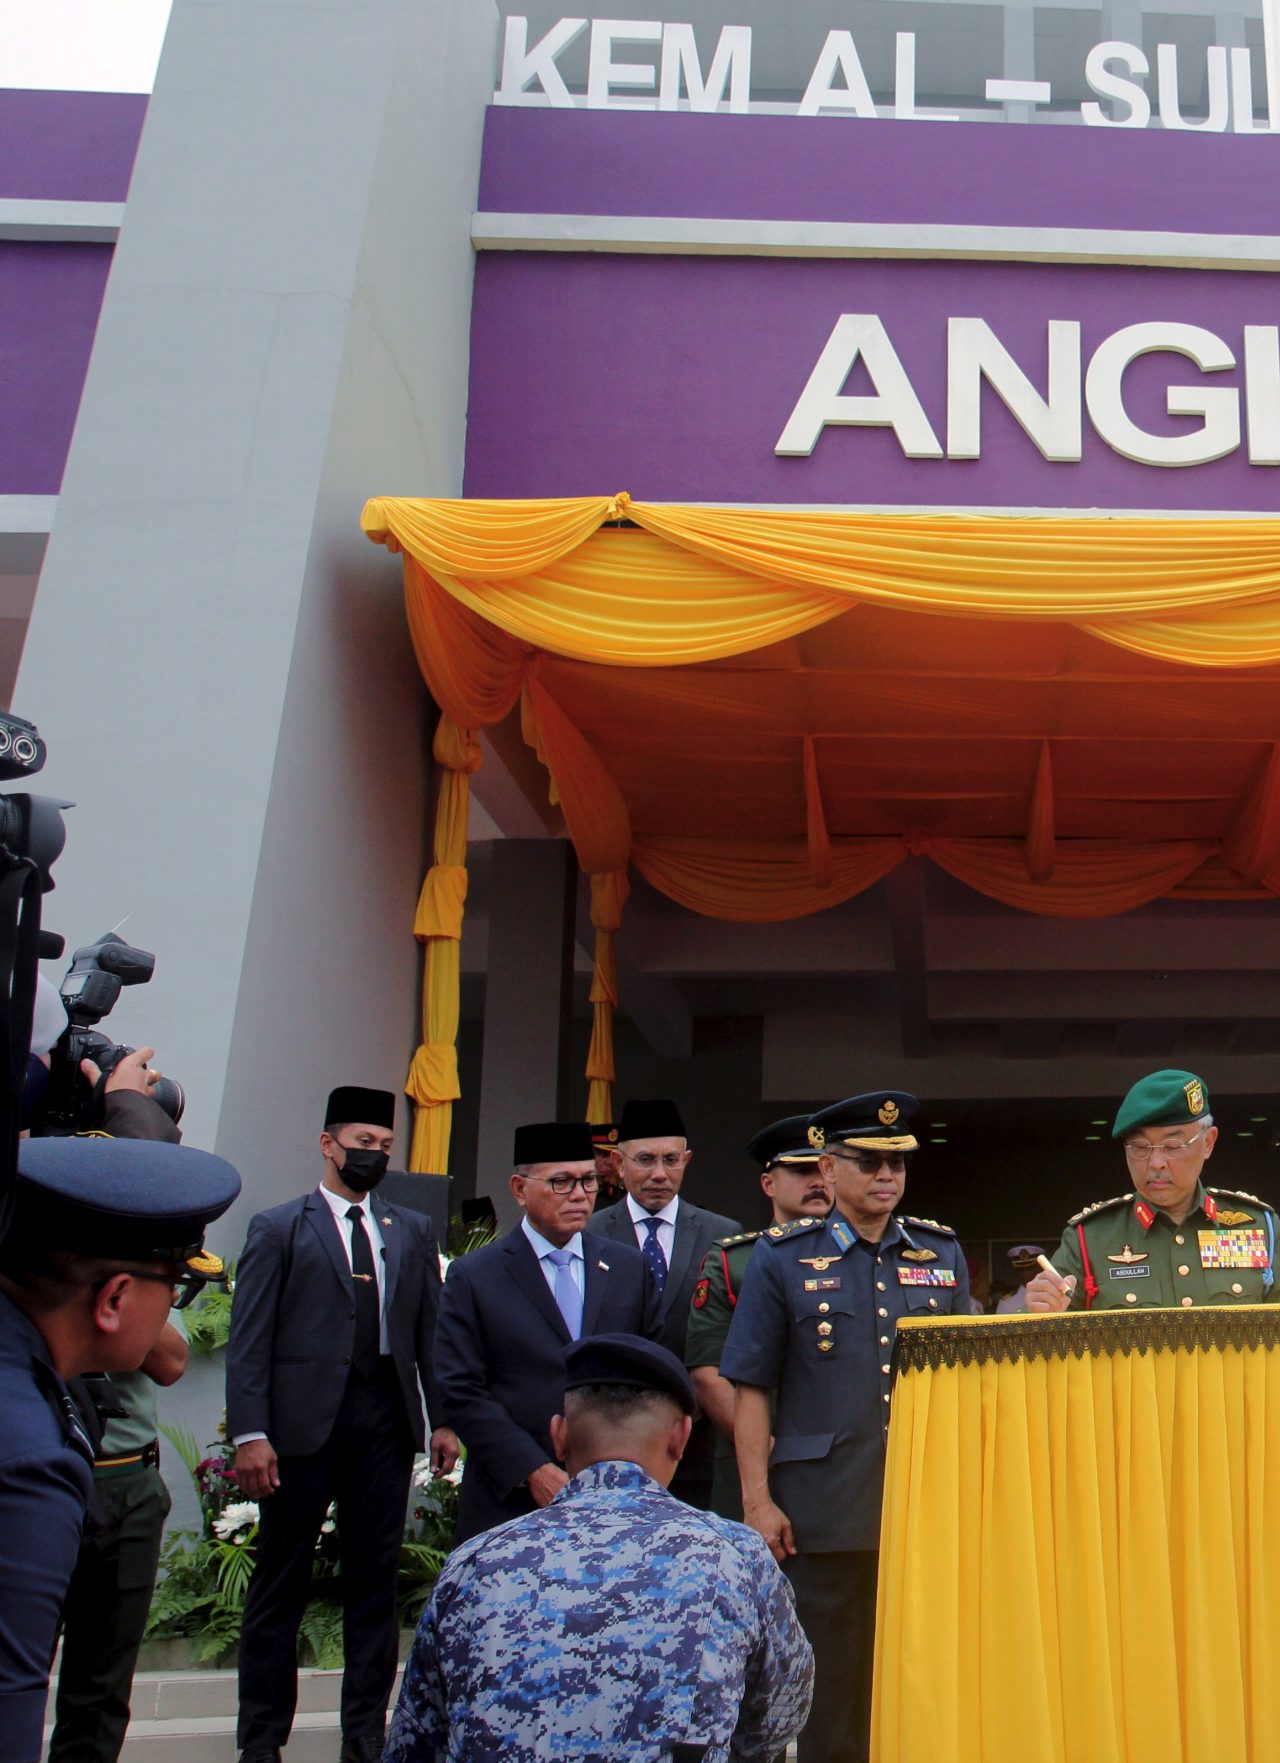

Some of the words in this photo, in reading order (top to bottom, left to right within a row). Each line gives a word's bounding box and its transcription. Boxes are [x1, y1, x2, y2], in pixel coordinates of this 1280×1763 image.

[500, 16, 752, 113] KEM
[796, 29, 960, 121] AL
[1115, 1268, 1146, 1277] ABDULLAH
